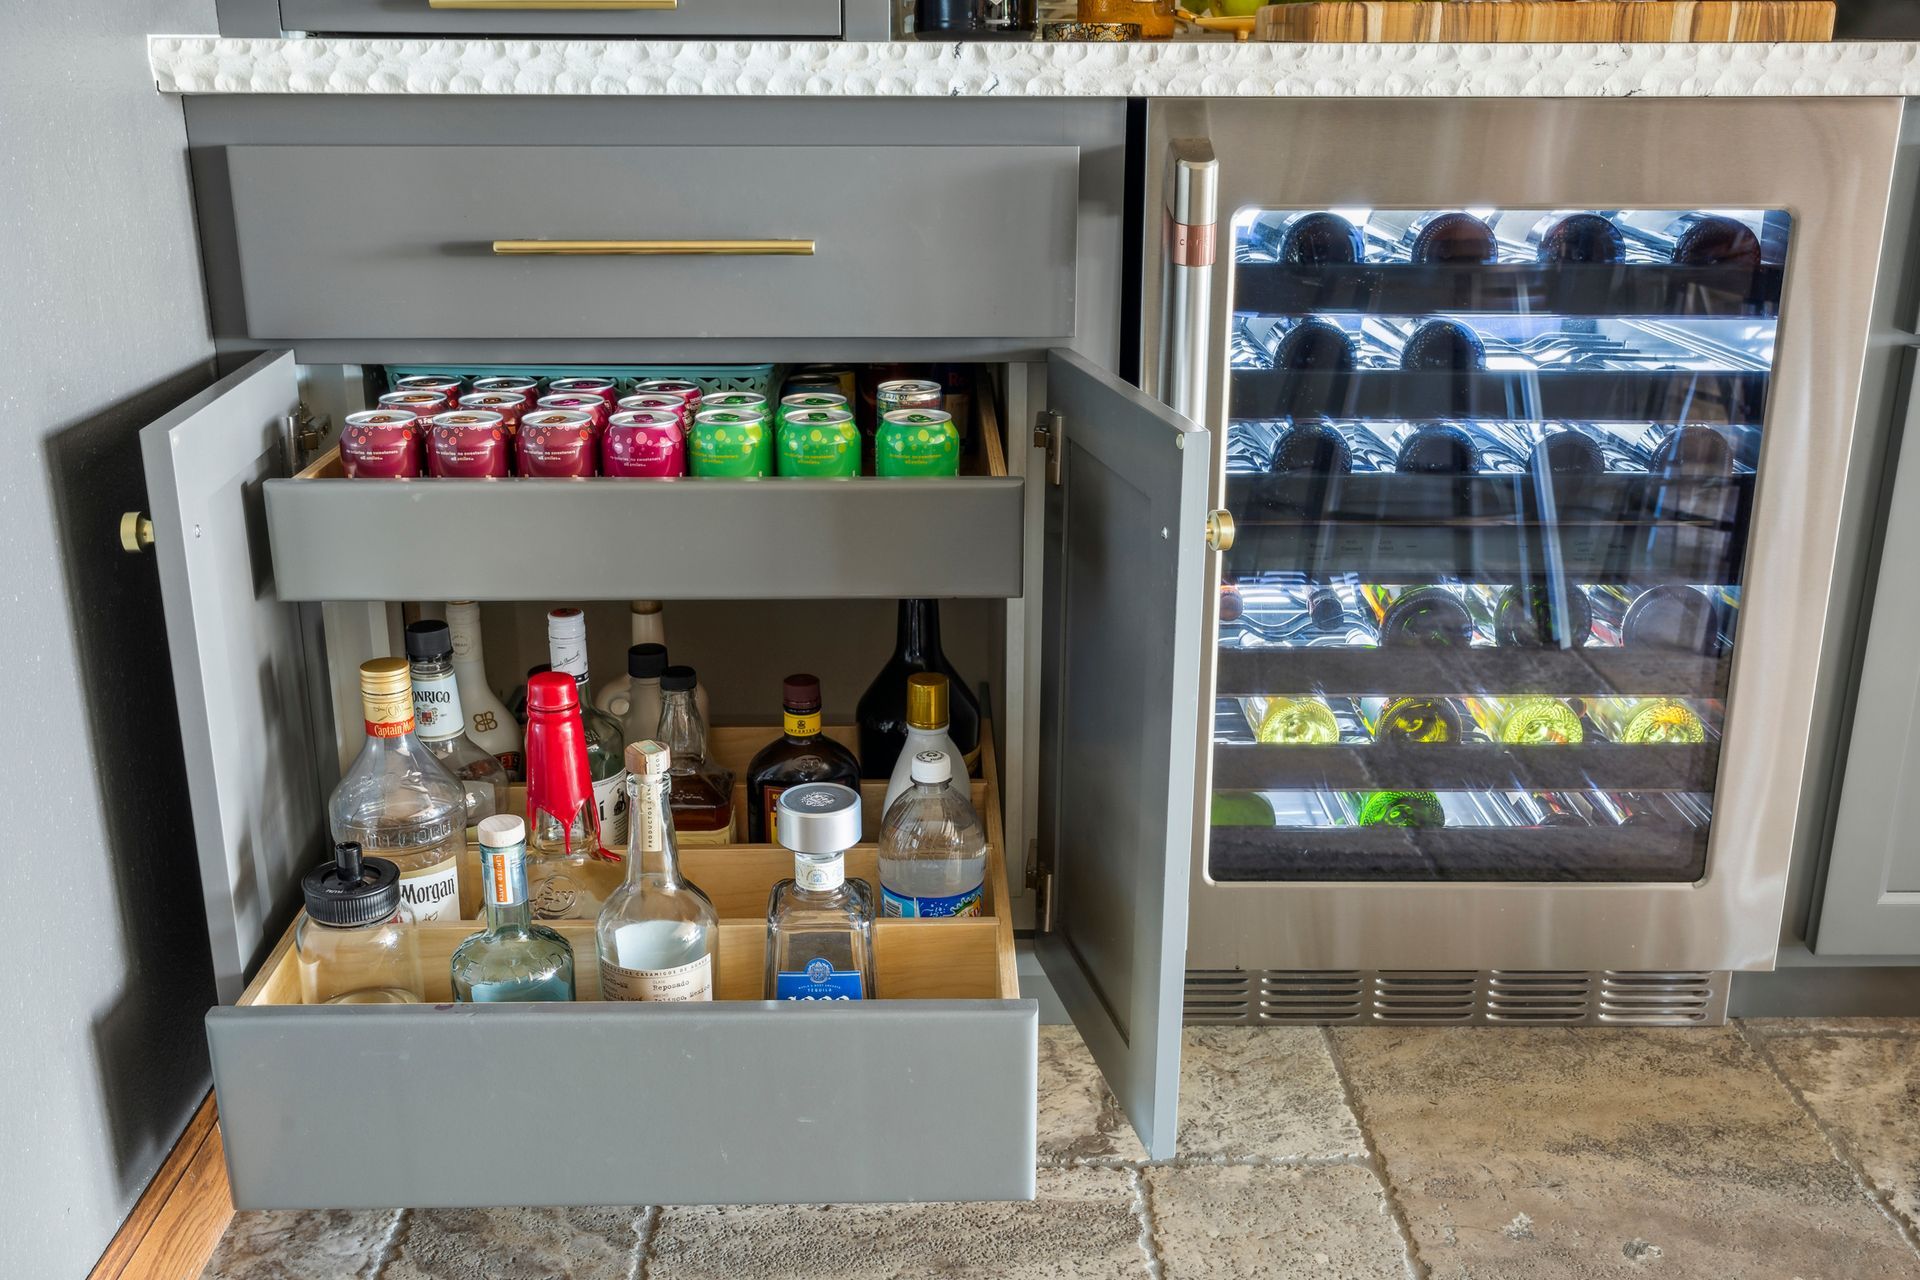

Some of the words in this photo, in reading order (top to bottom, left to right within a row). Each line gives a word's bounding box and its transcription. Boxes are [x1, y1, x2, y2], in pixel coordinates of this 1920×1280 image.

[374, 724, 402, 738] Captain
[401, 880, 454, 905] Morgan
[652, 980, 690, 992] Reposado
